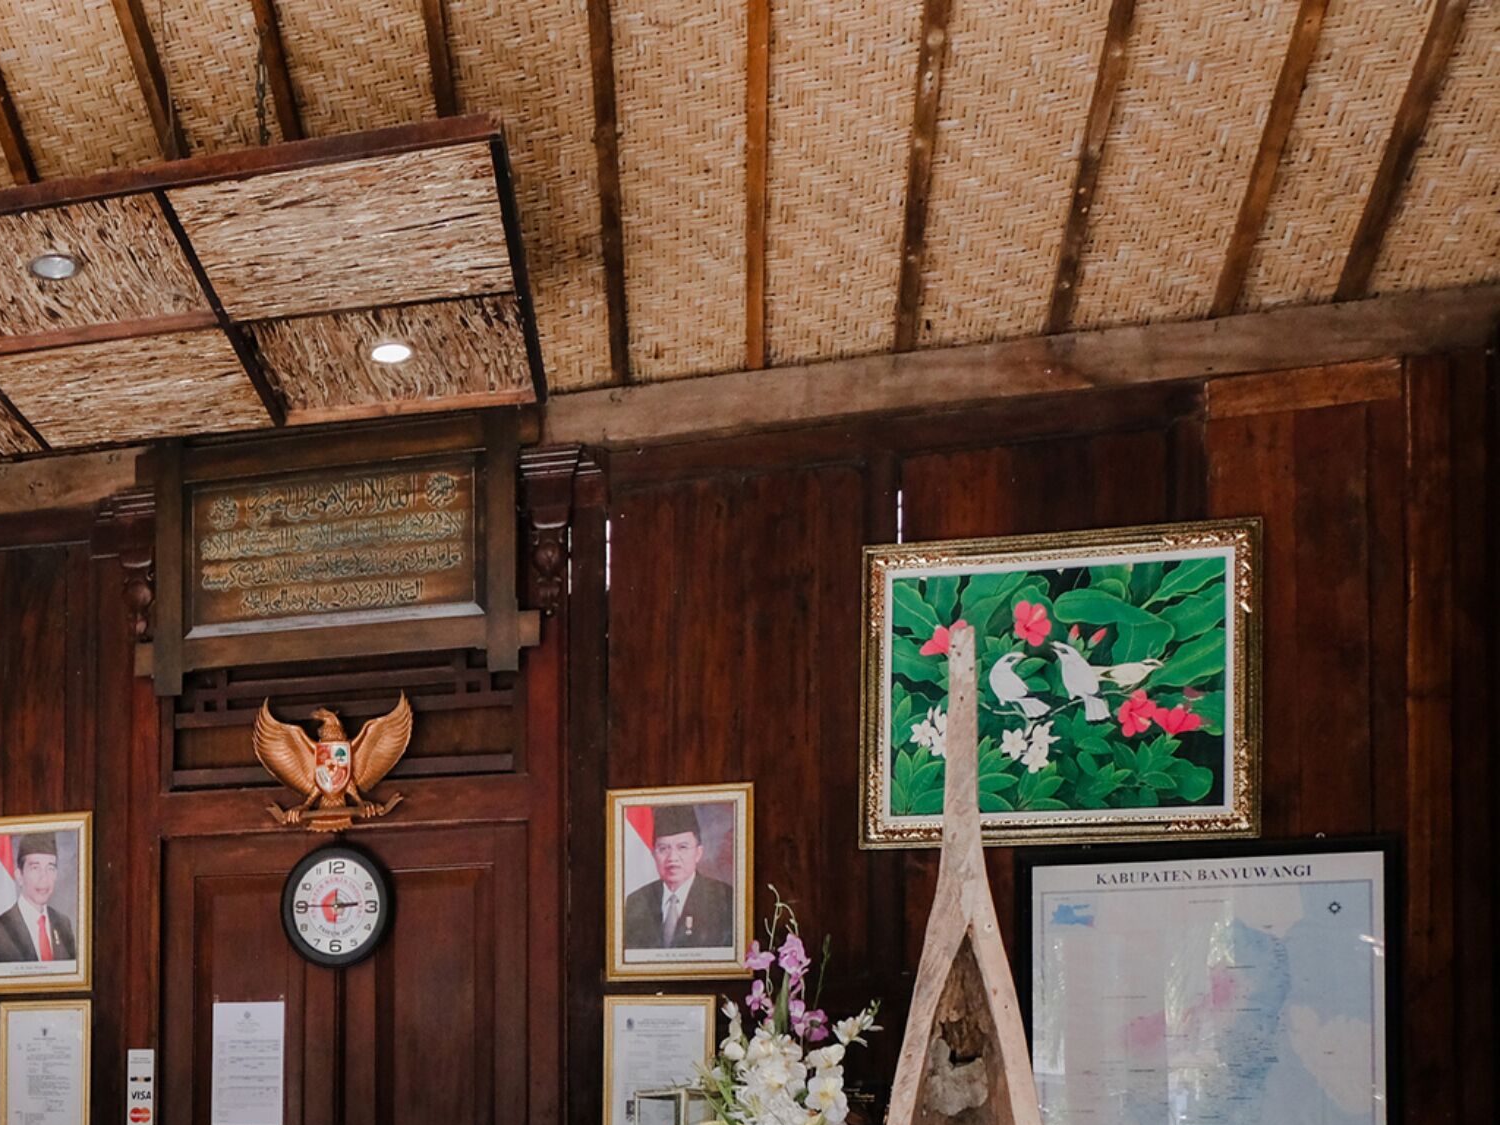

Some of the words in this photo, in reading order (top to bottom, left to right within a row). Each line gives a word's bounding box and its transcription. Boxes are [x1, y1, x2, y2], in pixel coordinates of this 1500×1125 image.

[328, 861, 346, 874] 12
[1096, 869, 1193, 885] KABUPATEN
[1197, 864, 1312, 881] BANYUWANGI
[301, 883, 311, 891] 10
[364, 882, 373, 890] 2
[295, 900, 308, 914] 9
[364, 900, 378, 914] 3
[300, 923, 308, 932] 8
[364, 923, 371, 931] 4
[313, 938, 321, 946] 7
[329, 939, 342, 953] 6
[132, 1091, 151, 1100] VISA
